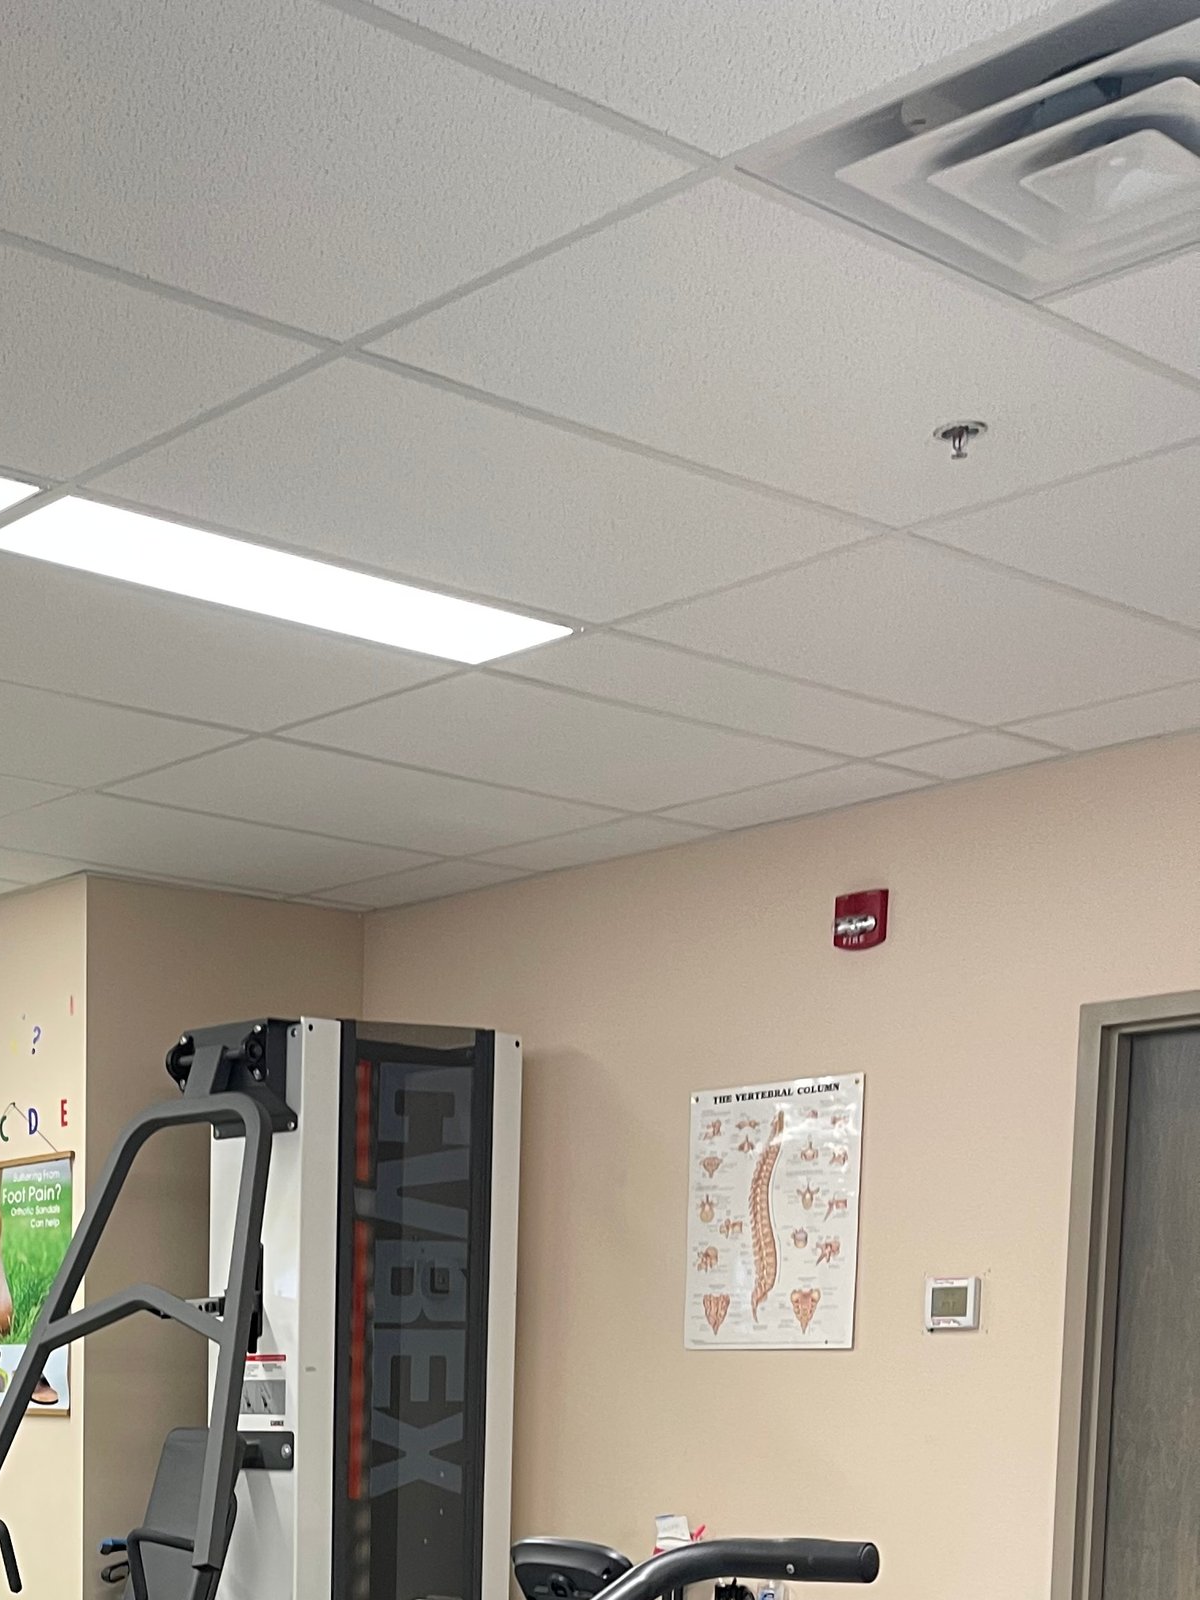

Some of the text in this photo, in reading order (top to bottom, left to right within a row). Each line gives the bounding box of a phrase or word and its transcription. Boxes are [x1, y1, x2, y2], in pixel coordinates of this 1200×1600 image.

[713, 1082, 840, 1105] THE VERTEBRAL COLUMN
[2, 1183, 62, 1206] Foot Pain?
[30, 1219, 44, 1228] Can
[354, 1060, 474, 1498] CYBEX
